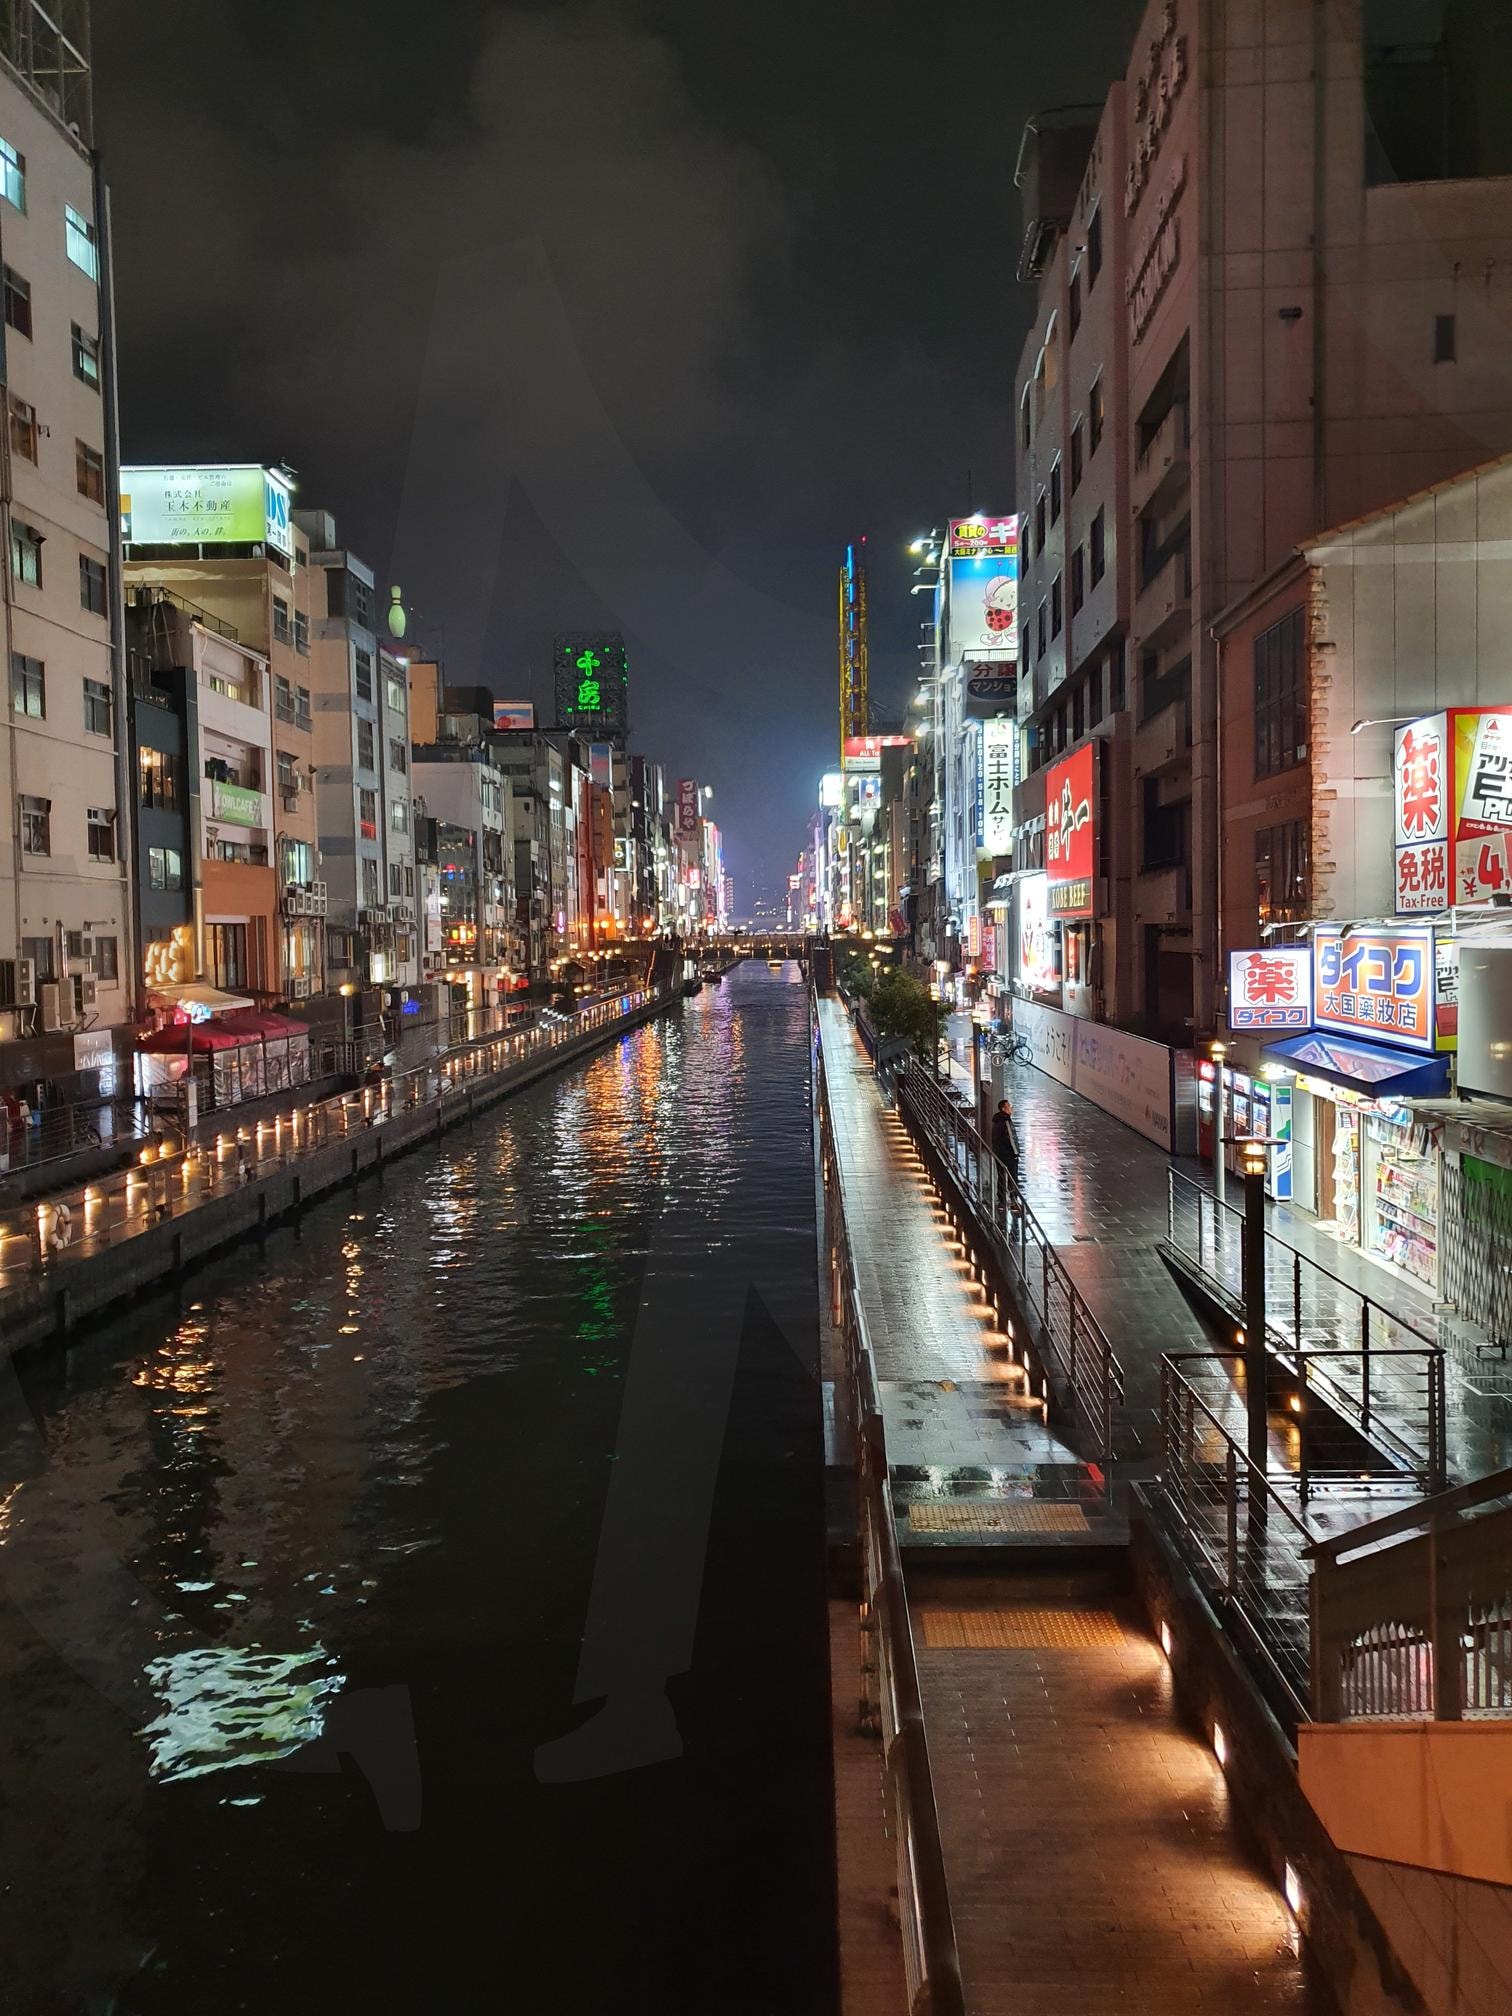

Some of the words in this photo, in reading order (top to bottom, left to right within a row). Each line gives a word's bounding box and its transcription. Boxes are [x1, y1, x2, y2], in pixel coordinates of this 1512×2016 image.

[164, 490, 202, 498] 株式会社
[265, 482, 286, 529] DS
[973, 663, 1017, 677] 分譲
[1401, 729, 1440, 834] 薬
[1472, 771, 1512, 802] E
[1398, 846, 1445, 893] 免税
[1052, 886, 1068, 909] KOBE
[1069, 883, 1086, 907] BEEF
[1399, 894, 1444, 909] Tax-Free
[1246, 953, 1298, 1005] 薬
[1320, 943, 1423, 998] ダイコク
[1236, 1007, 1305, 1026] ダイコク
